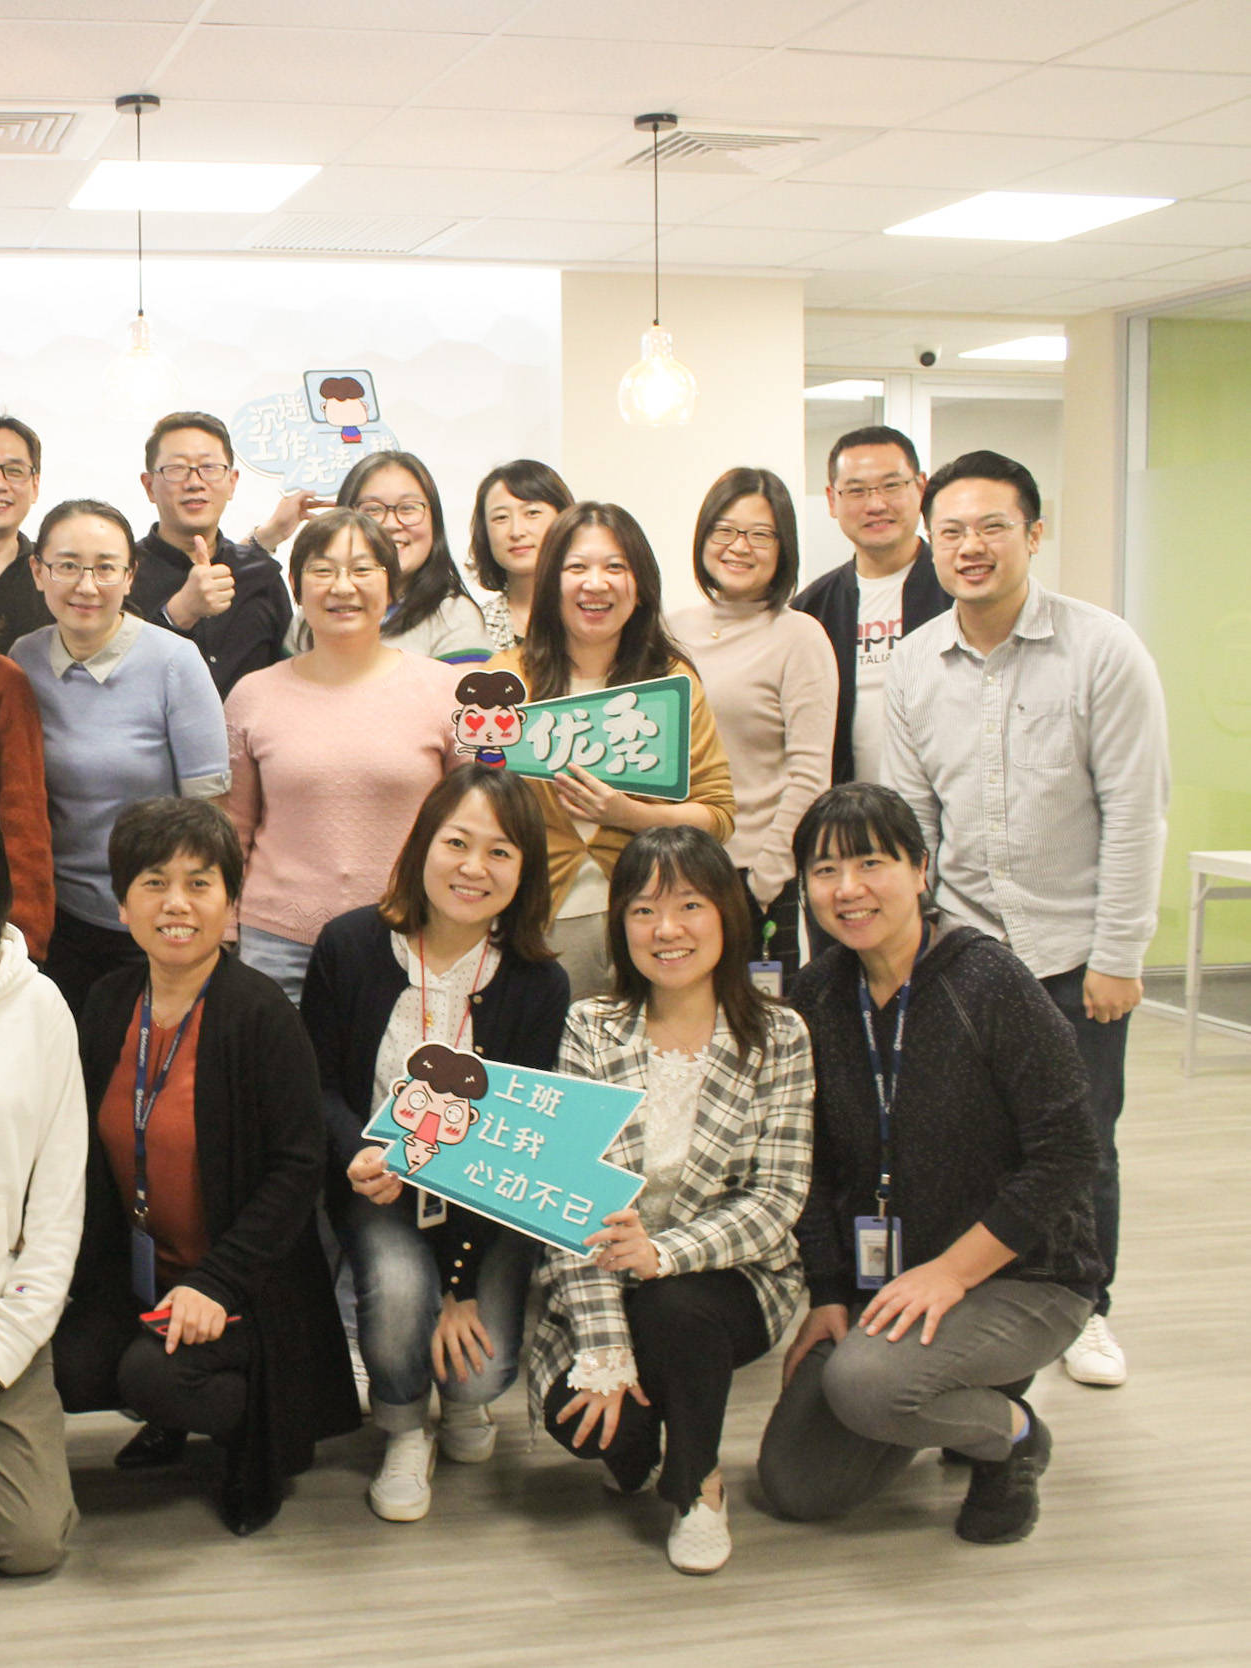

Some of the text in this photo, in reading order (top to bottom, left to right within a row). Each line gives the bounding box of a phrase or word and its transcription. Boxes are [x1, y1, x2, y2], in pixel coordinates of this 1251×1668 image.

[526, 691, 659, 774] 优秀
[493, 1074, 565, 1118] 上班
[477, 1112, 545, 1160] 让我
